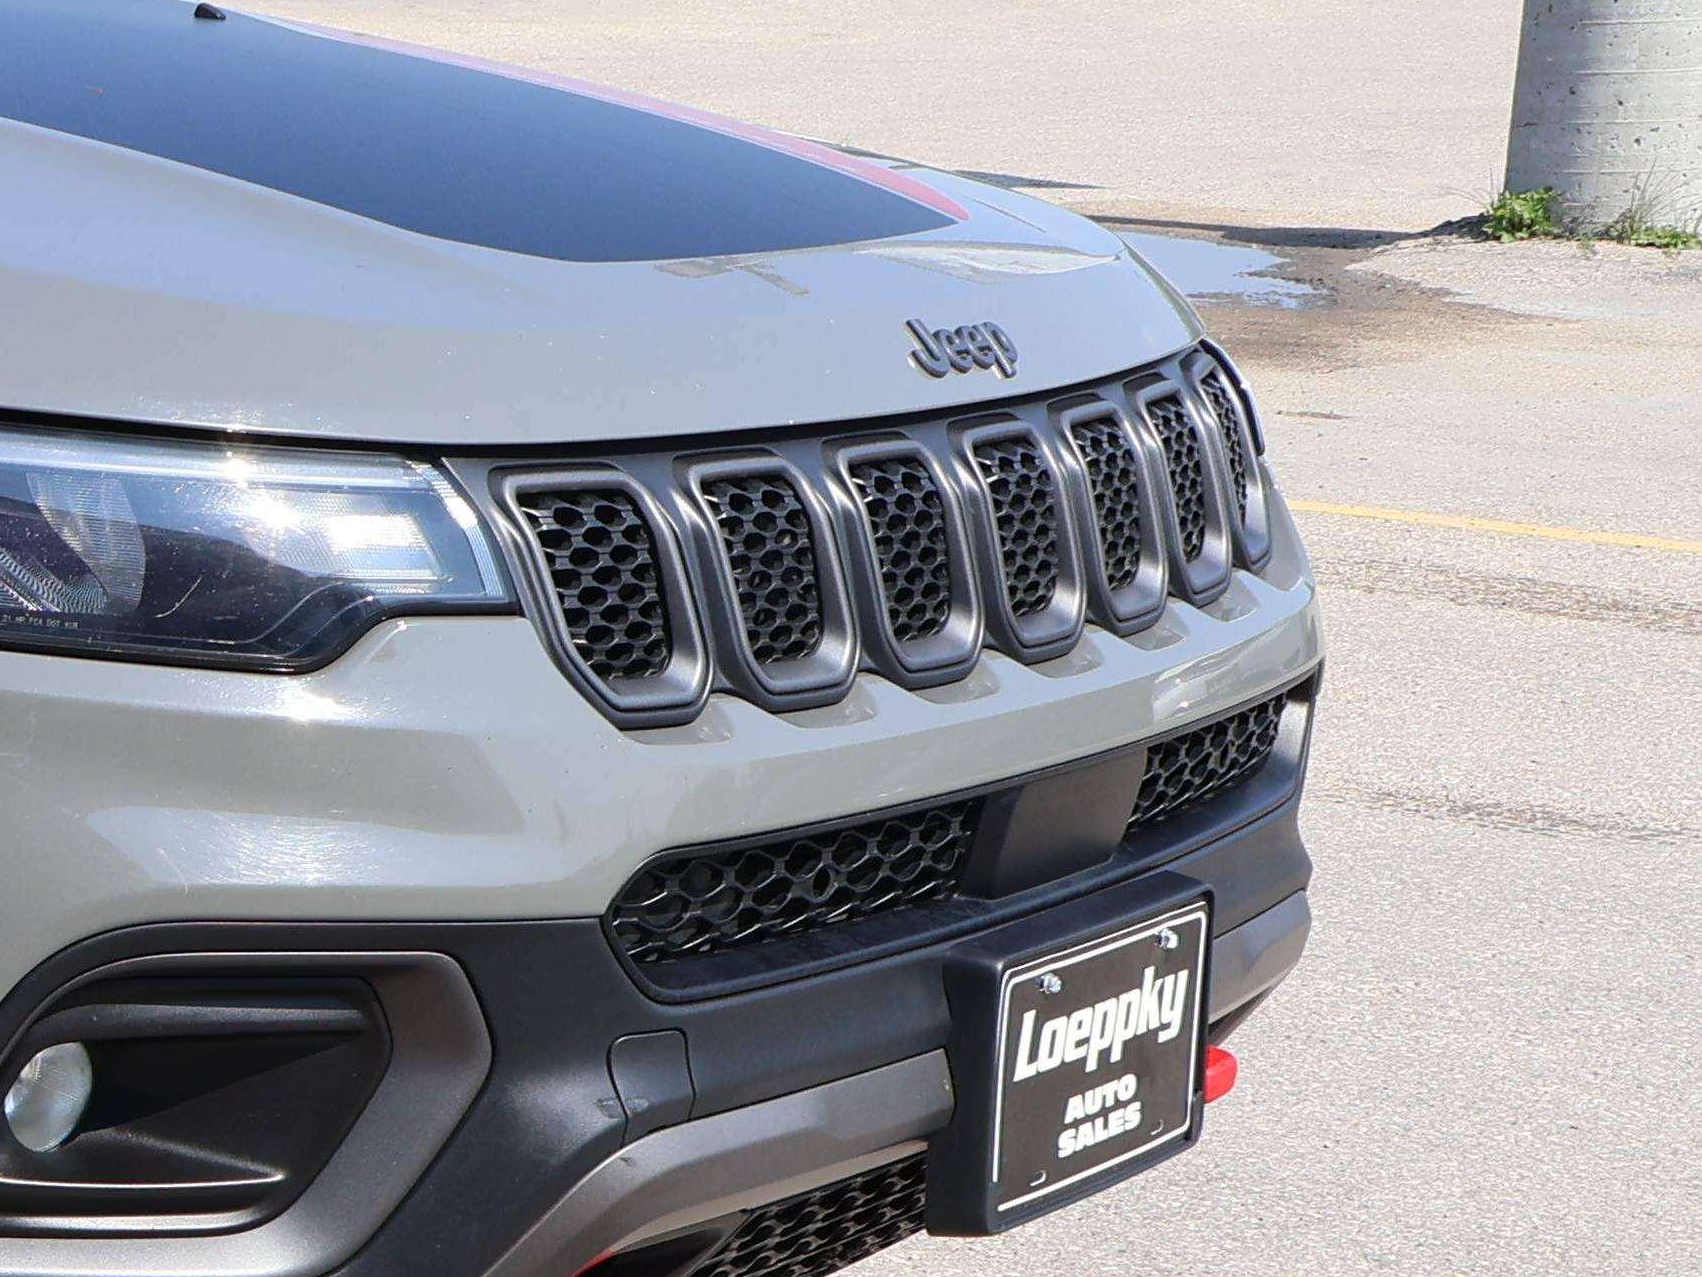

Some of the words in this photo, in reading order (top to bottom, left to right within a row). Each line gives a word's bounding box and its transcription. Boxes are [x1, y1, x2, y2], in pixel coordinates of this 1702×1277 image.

[905, 318, 1019, 379] Jeep
[1012, 965, 1190, 1083] Loeppky
[1064, 1073, 1138, 1124] AUTO
[1057, 1101, 1143, 1159] SALES
